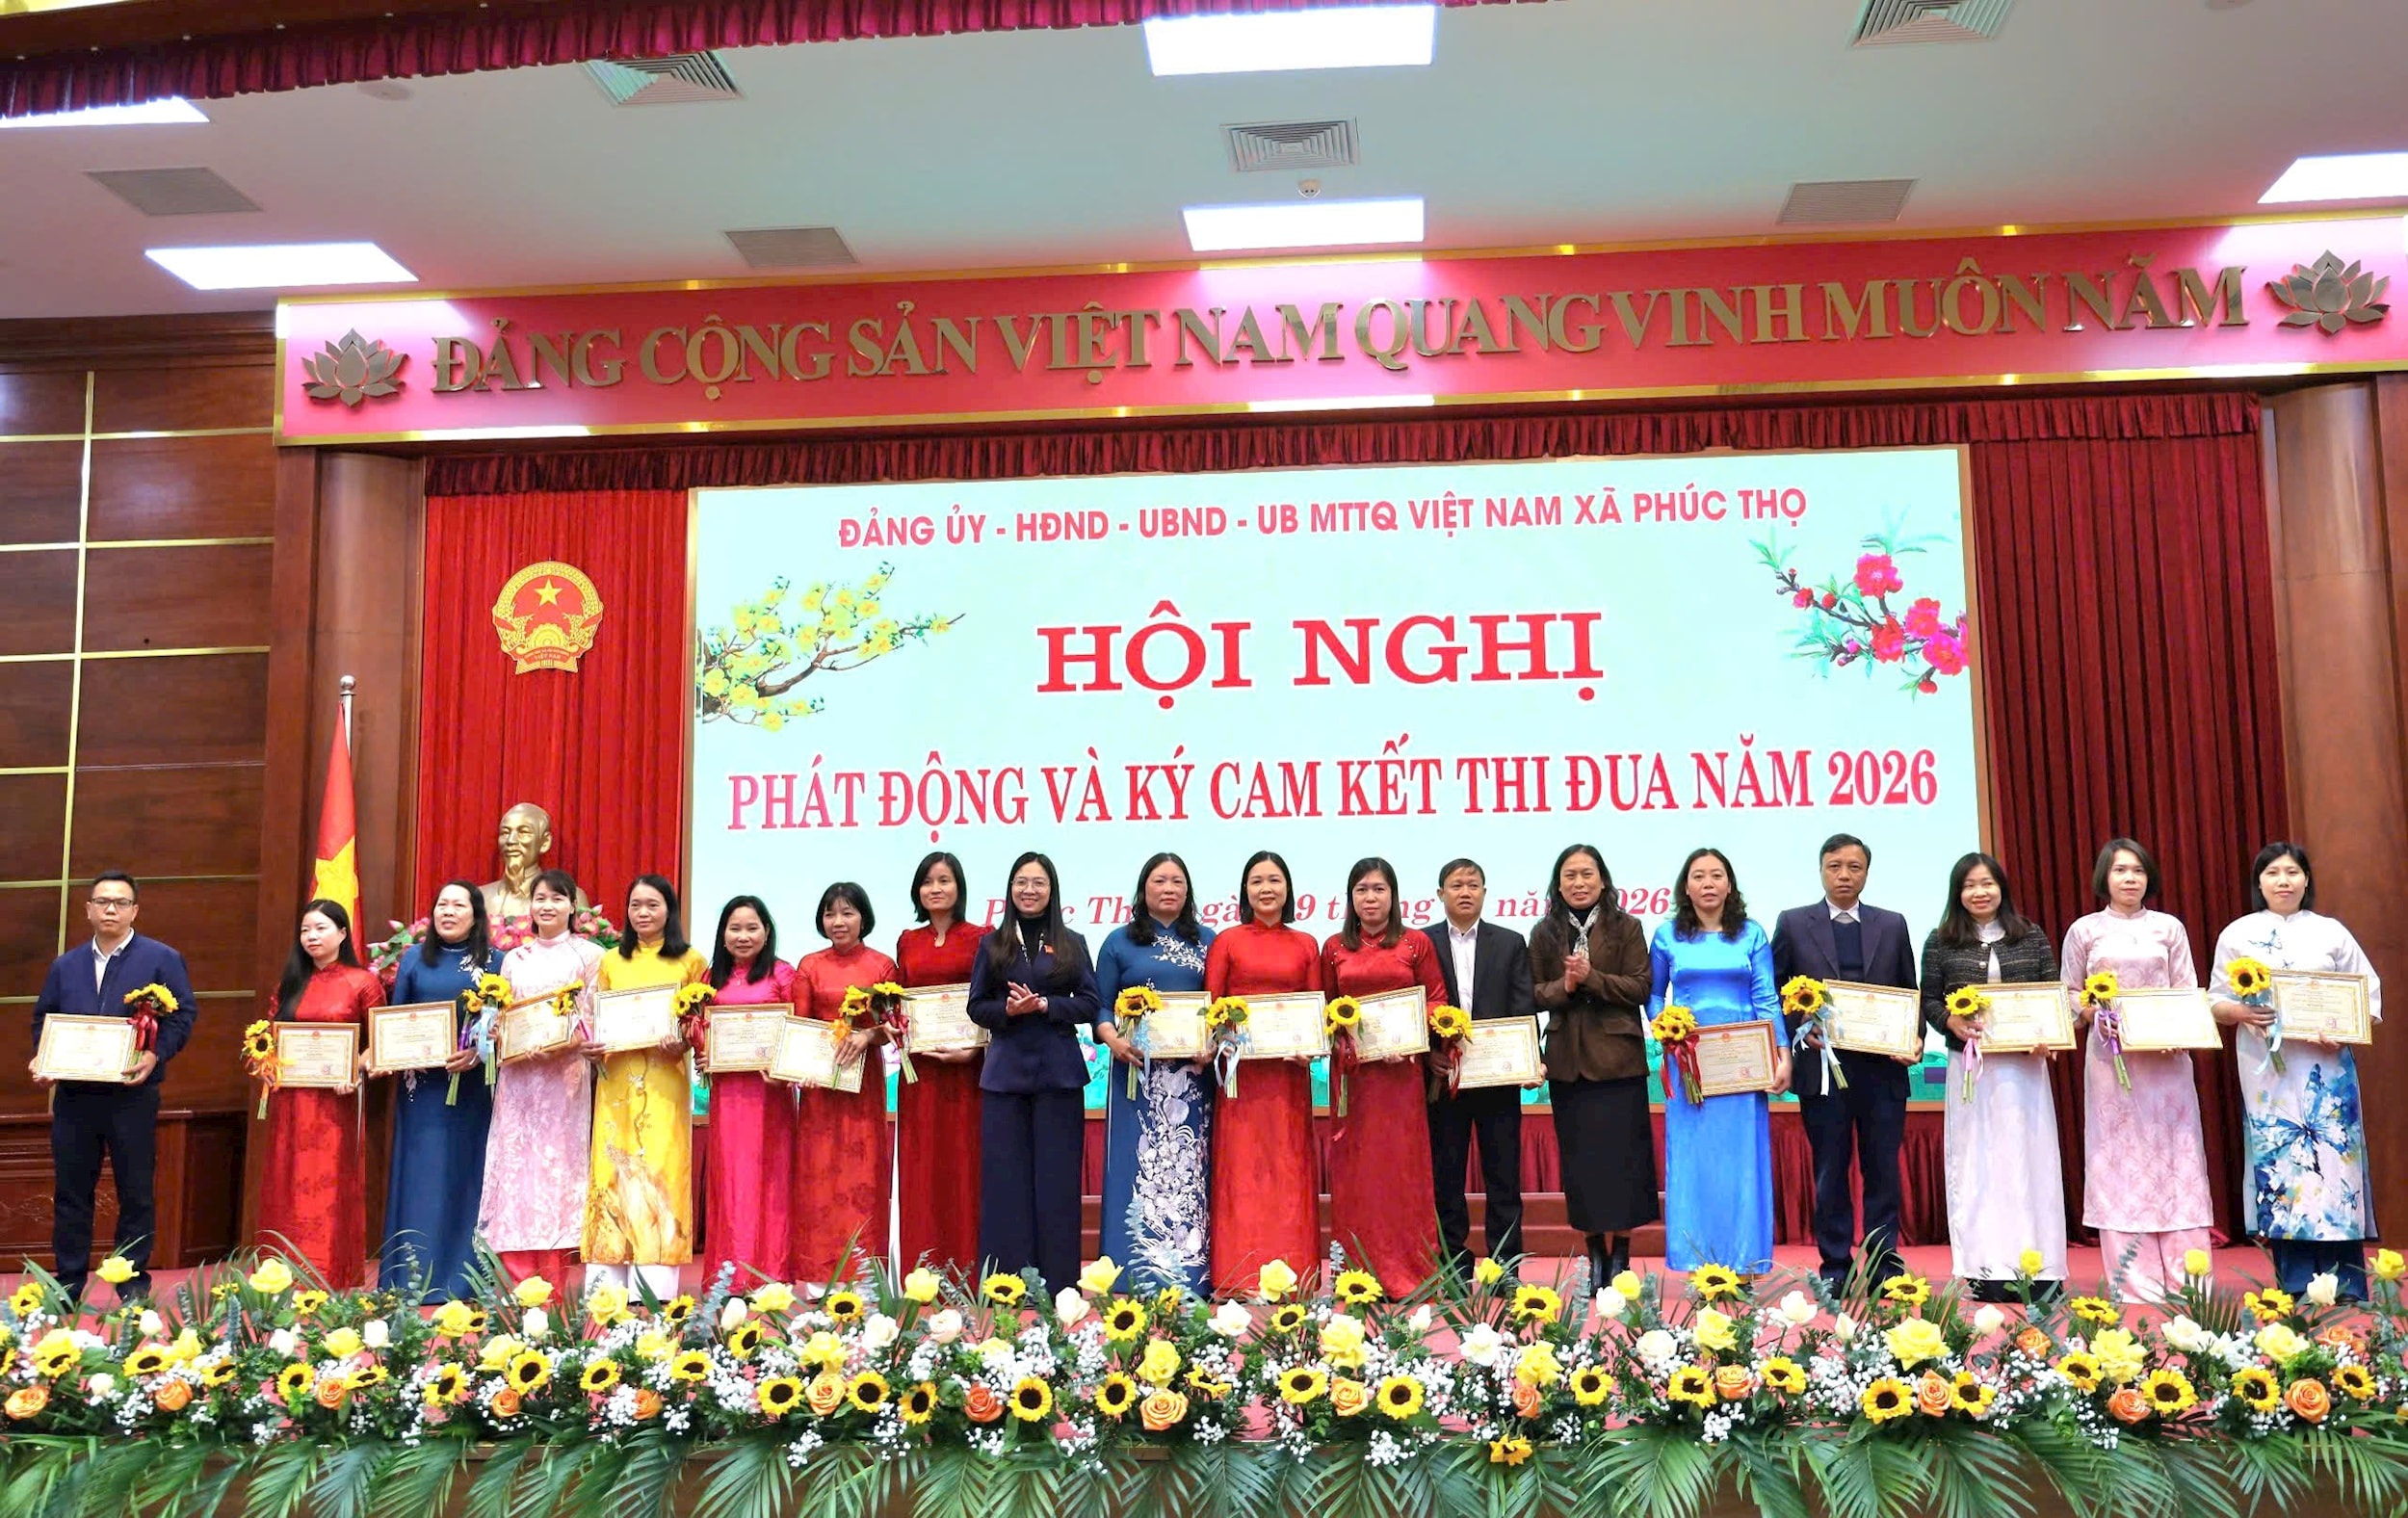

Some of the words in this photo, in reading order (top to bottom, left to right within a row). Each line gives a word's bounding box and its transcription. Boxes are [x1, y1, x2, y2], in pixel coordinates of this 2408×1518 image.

[431, 317, 626, 392] ĐẢNG
[640, 314, 835, 401] CỘNG
[848, 301, 981, 377] SẢN
[993, 301, 1160, 384] VIỆT
[1174, 301, 1345, 368] NAM
[1354, 293, 1607, 371] QUANG
[1607, 283, 1810, 351] VINH
[1819, 256, 2051, 340] MUÔN
[2061, 252, 2250, 332] NĂM
[839, 507, 934, 547] ĐẢNG
[947, 504, 986, 545] ỦY
[1016, 510, 1110, 541] HĐND
[1139, 507, 1227, 538] UBND
[1257, 505, 1299, 535] UB
[1310, 501, 1399, 533] MTTQ
[1408, 490, 1474, 537] VIỆT
[1485, 495, 1561, 527] NAM
[1575, 486, 1622, 524] XÃ
[1634, 483, 1727, 522] PHÚC
[1738, 488, 1807, 527] THỌ
[1036, 599, 1253, 710] HỘI
[1292, 612, 1604, 701] NGHỊ
[728, 754, 865, 830] PHÁT
[877, 750, 1029, 843] ĐỘNG
[1041, 746, 1112, 823] VÀ
[1125, 745, 1195, 821] KÝ
[1210, 760, 1322, 820] CAM
[1337, 733, 1442, 817] KẾT
[1456, 755, 1551, 814] THI
[1565, 752, 1679, 812] ĐUA
[1690, 733, 1814, 810] NĂM
[1827, 748, 1938, 807] 2026
